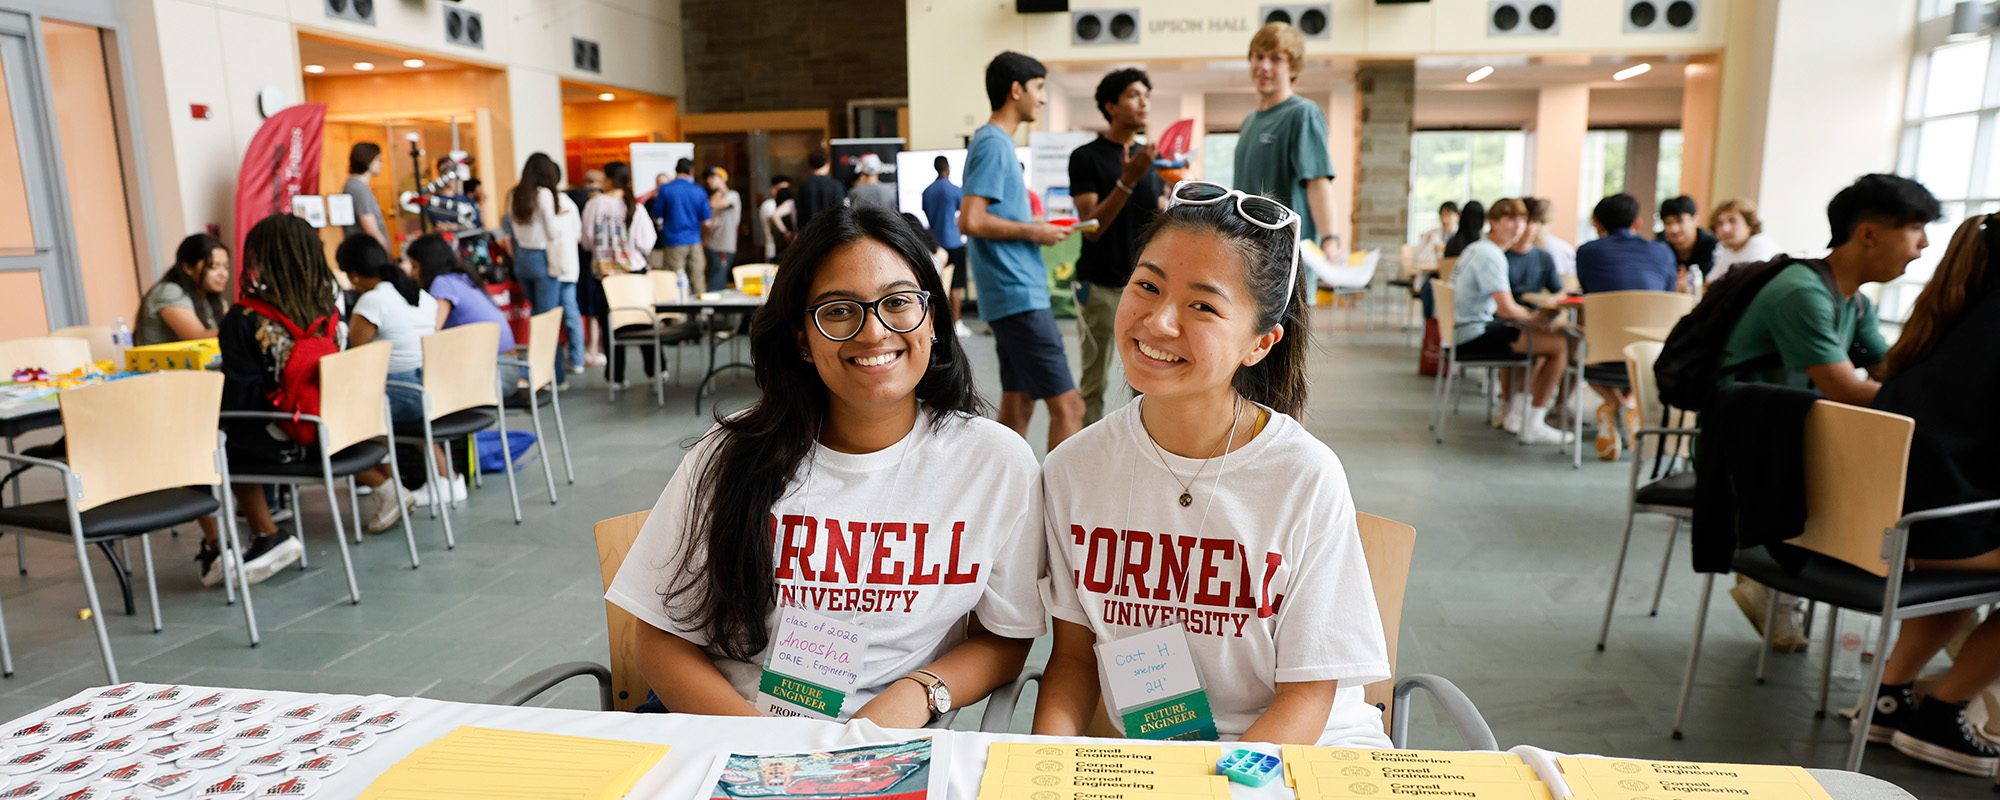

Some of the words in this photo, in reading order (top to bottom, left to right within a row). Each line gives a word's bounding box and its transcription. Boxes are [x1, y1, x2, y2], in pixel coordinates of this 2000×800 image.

[1208, 16, 1247, 31] HALL
[770, 513, 980, 585] RNELL
[1103, 599, 1249, 638] UNIVERSITY
[785, 616, 808, 628] class
[814, 622, 826, 633] of
[827, 627, 859, 643] 2026
[779, 630, 850, 664] Anoosha
[1115, 649, 1145, 666] Cat
[812, 660, 858, 685] Engineering
[772, 685, 826, 711] ENGINEER
[781, 679, 824, 699] FUTURE
[1140, 710, 1197, 734] ENGINEER
[1143, 702, 1187, 723] FUTURE
[1654, 768, 1738, 778] Engineering
[1073, 781, 1154, 790] Engineering
[1391, 789, 1476, 798] Engineering
[1662, 785, 1749, 795] Engineering
